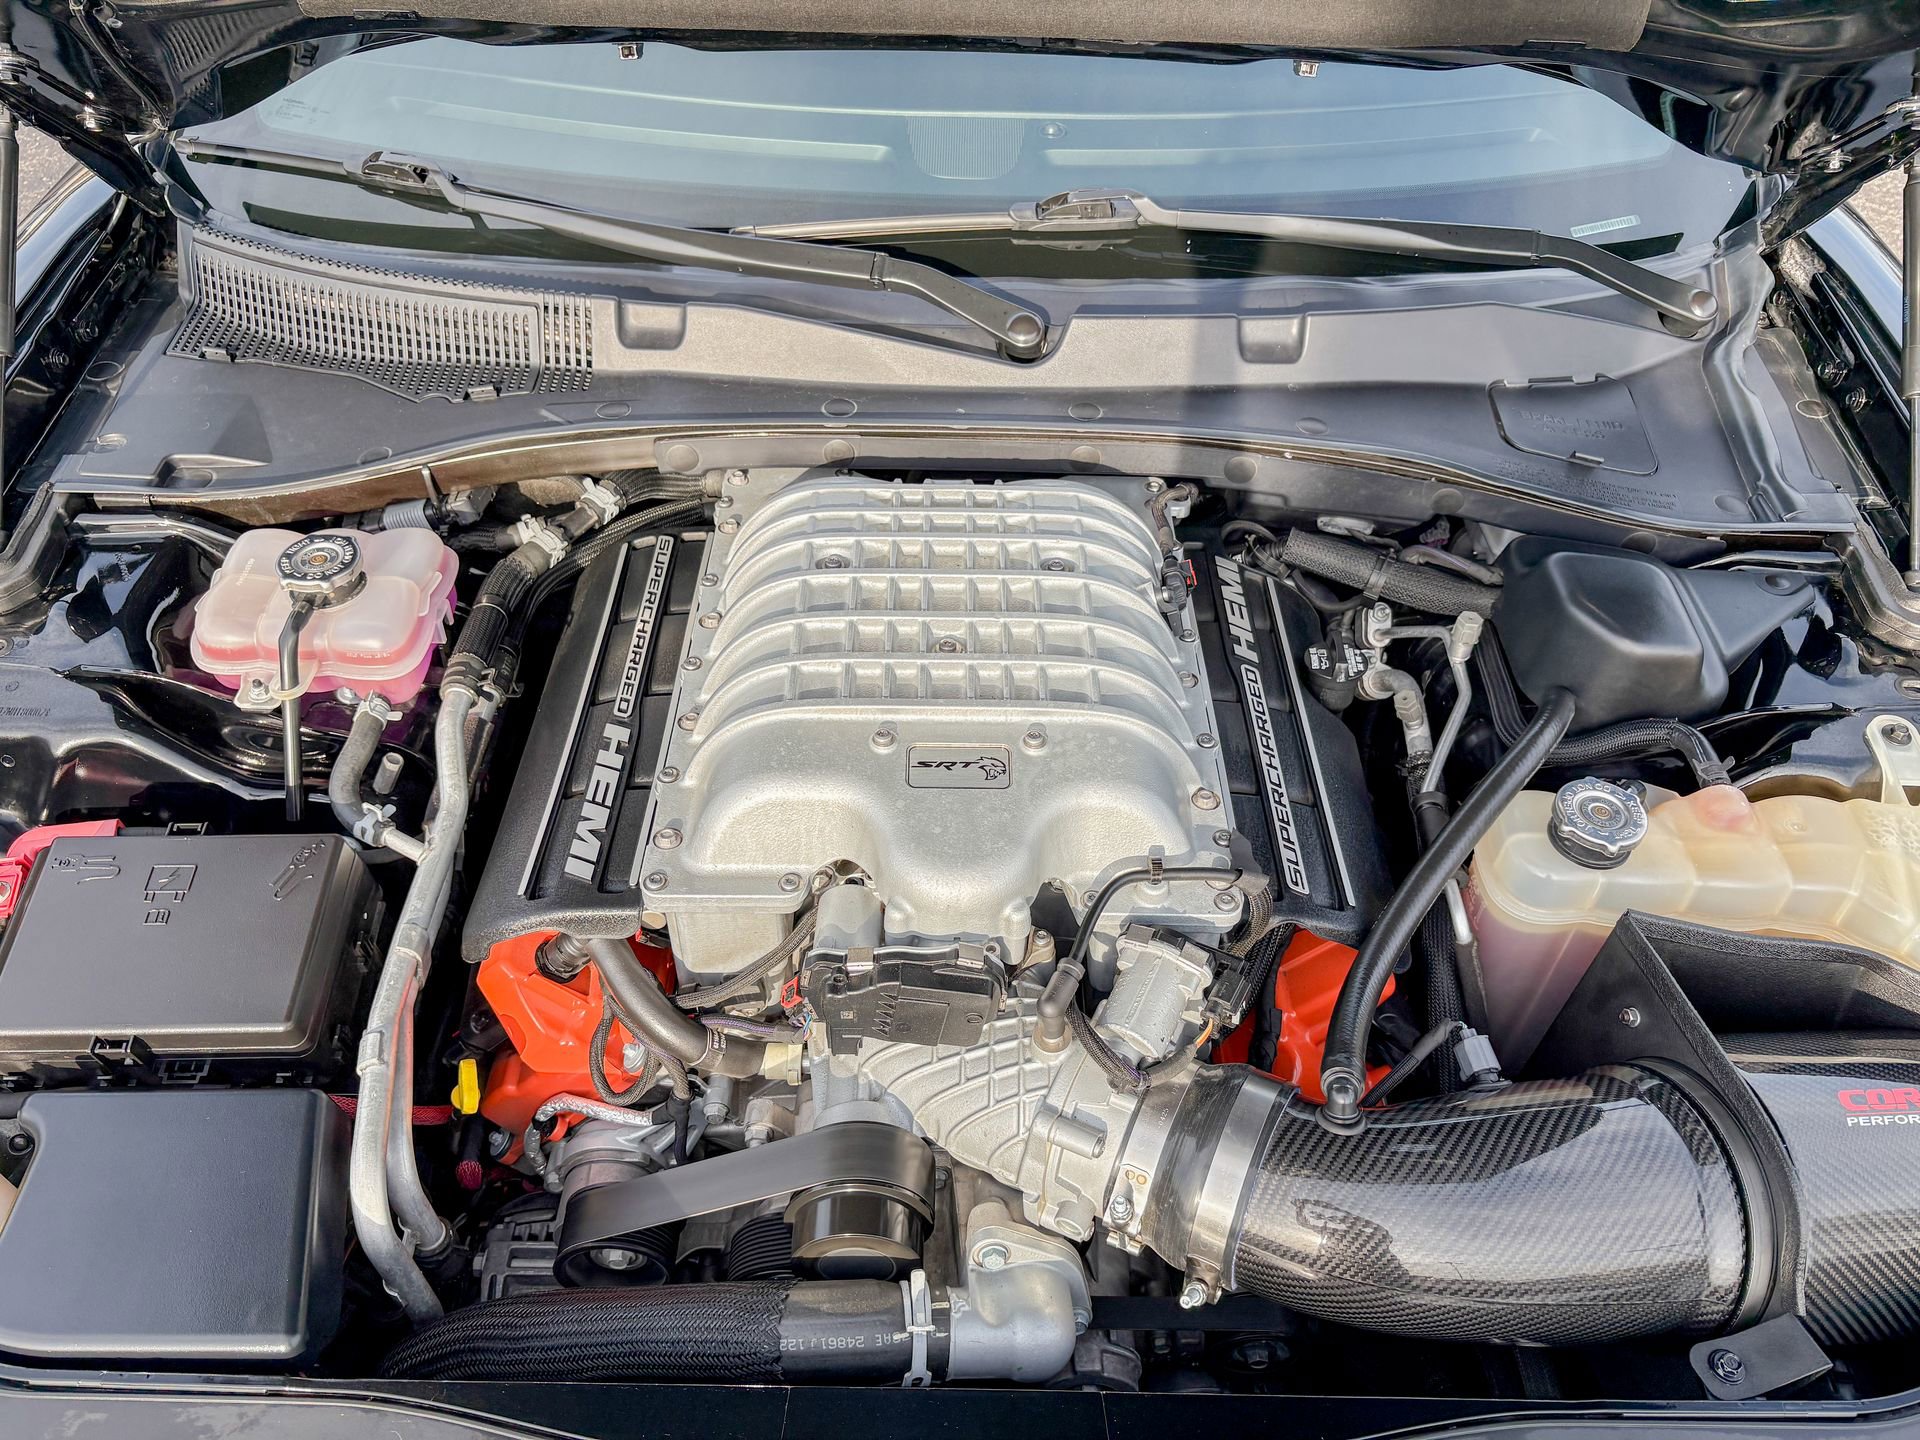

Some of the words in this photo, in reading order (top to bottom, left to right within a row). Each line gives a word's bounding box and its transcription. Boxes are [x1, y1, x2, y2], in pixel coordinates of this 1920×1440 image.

[285, 538, 311, 555] TIGHT
[280, 557, 294, 575] KEEP
[306, 572, 323, 580] DO
[325, 562, 345, 576] NOT
[1214, 555, 1259, 664] HEMI
[617, 538, 671, 714] SUPERCHARGED
[911, 760, 981, 771] SRT
[1244, 667, 1305, 891] SUPERCHARGED
[1594, 783, 1611, 793] DO
[1571, 783, 1593, 794] NOT
[564, 722, 632, 884] HEMI
[1626, 800, 1642, 824] KEEP
[1846, 1114, 1920, 1127] PERFOR
